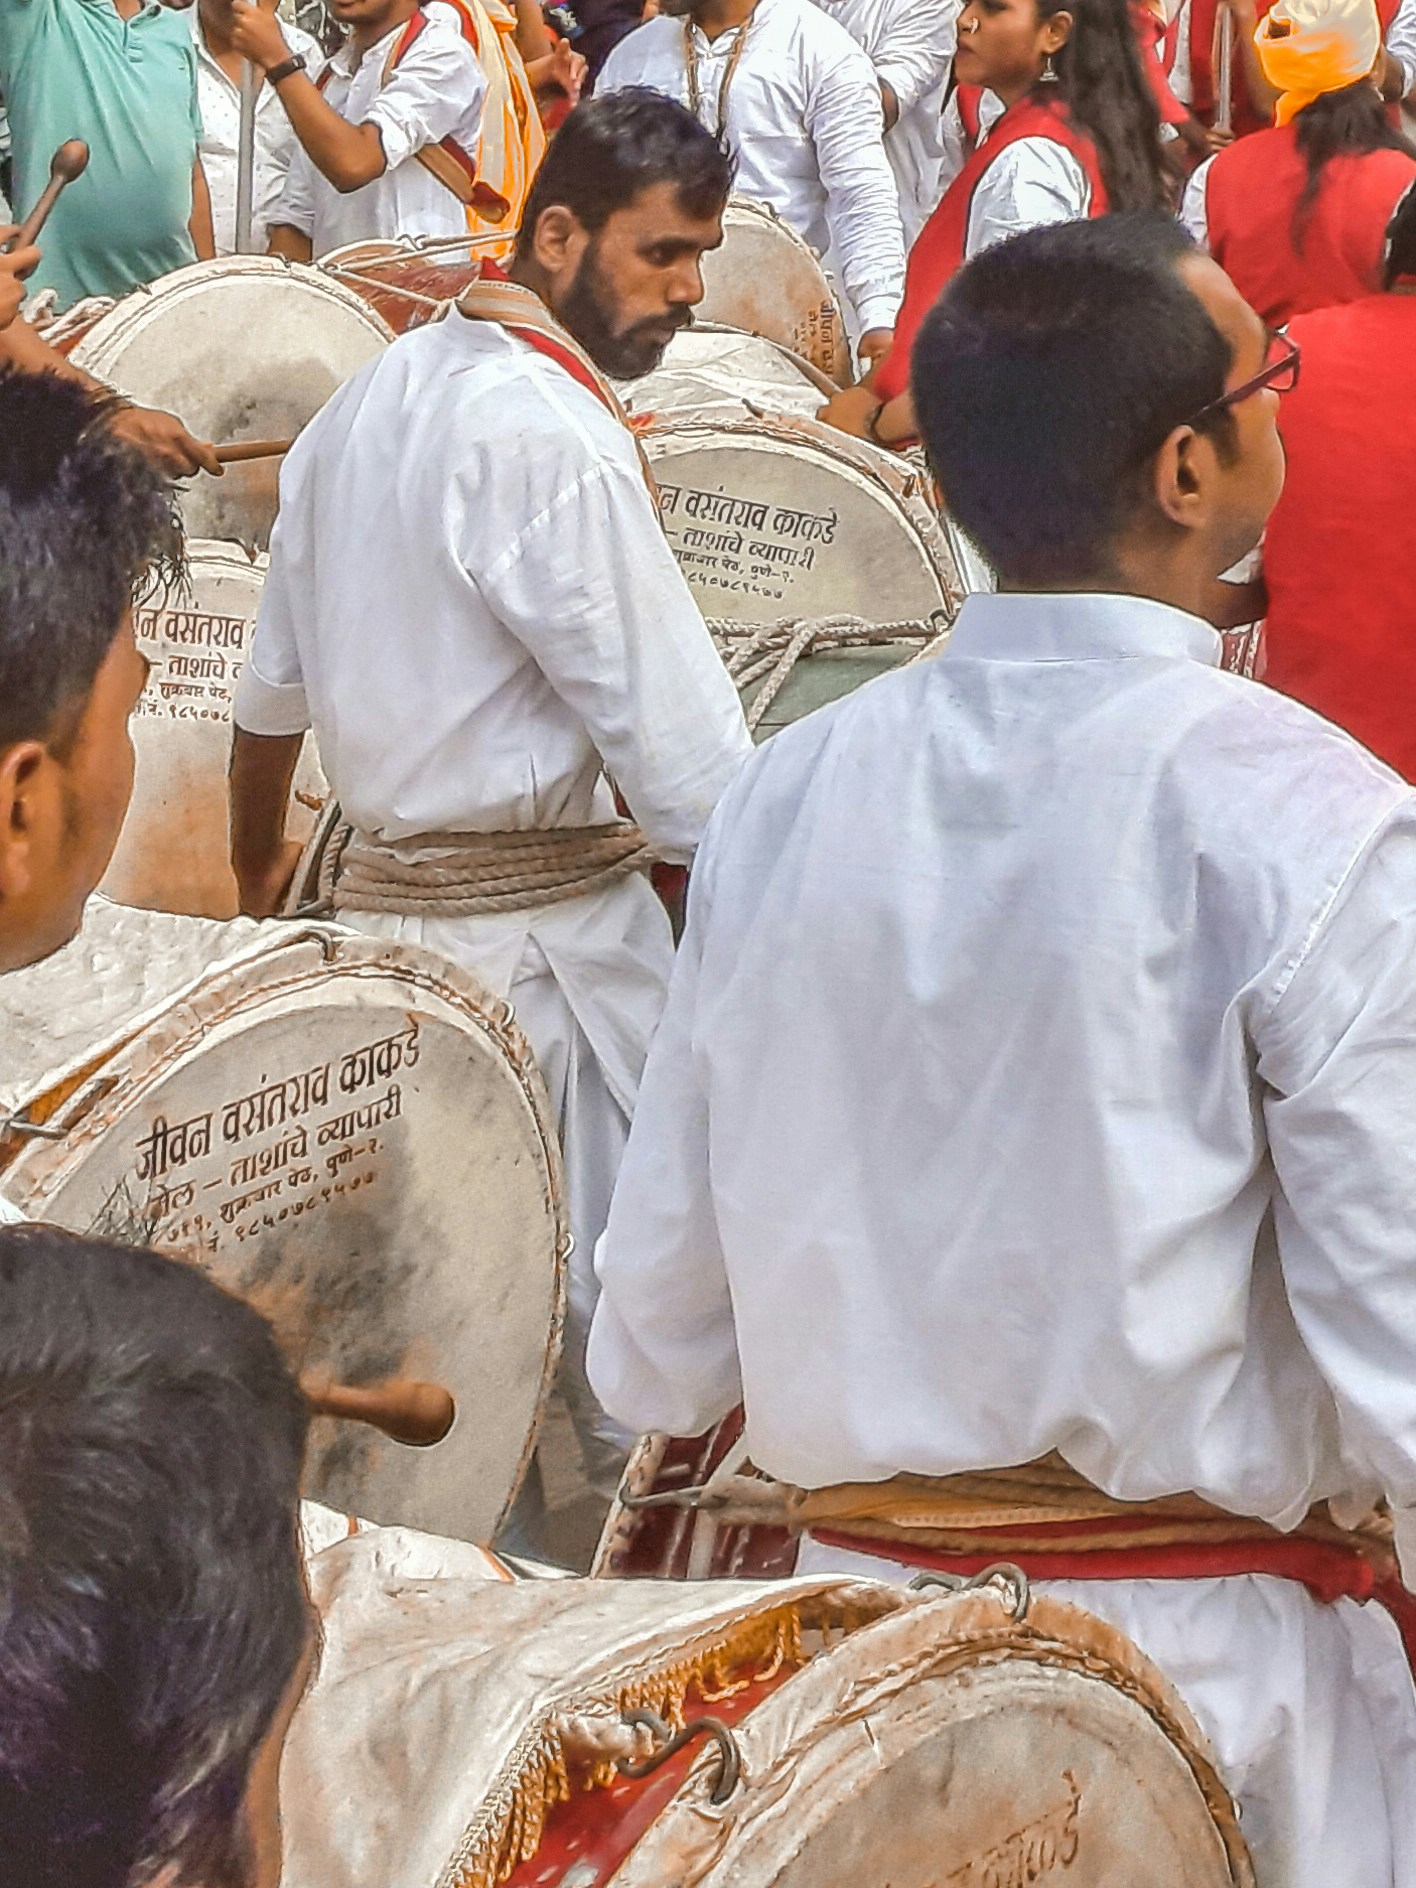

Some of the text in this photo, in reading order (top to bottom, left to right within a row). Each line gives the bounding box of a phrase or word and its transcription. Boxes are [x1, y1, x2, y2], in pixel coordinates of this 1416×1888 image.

[684, 484, 771, 532] वसंतराव
[771, 506, 842, 545] काकडे
[165, 600, 247, 650] वसंतराव
[167, 650, 227, 680] ताशांचे
[135, 1012, 421, 1181] जीवन वसंतराव काकडे
[229, 1124, 308, 1189] ताशांचे
[316, 1082, 402, 1147] व्यापारी
